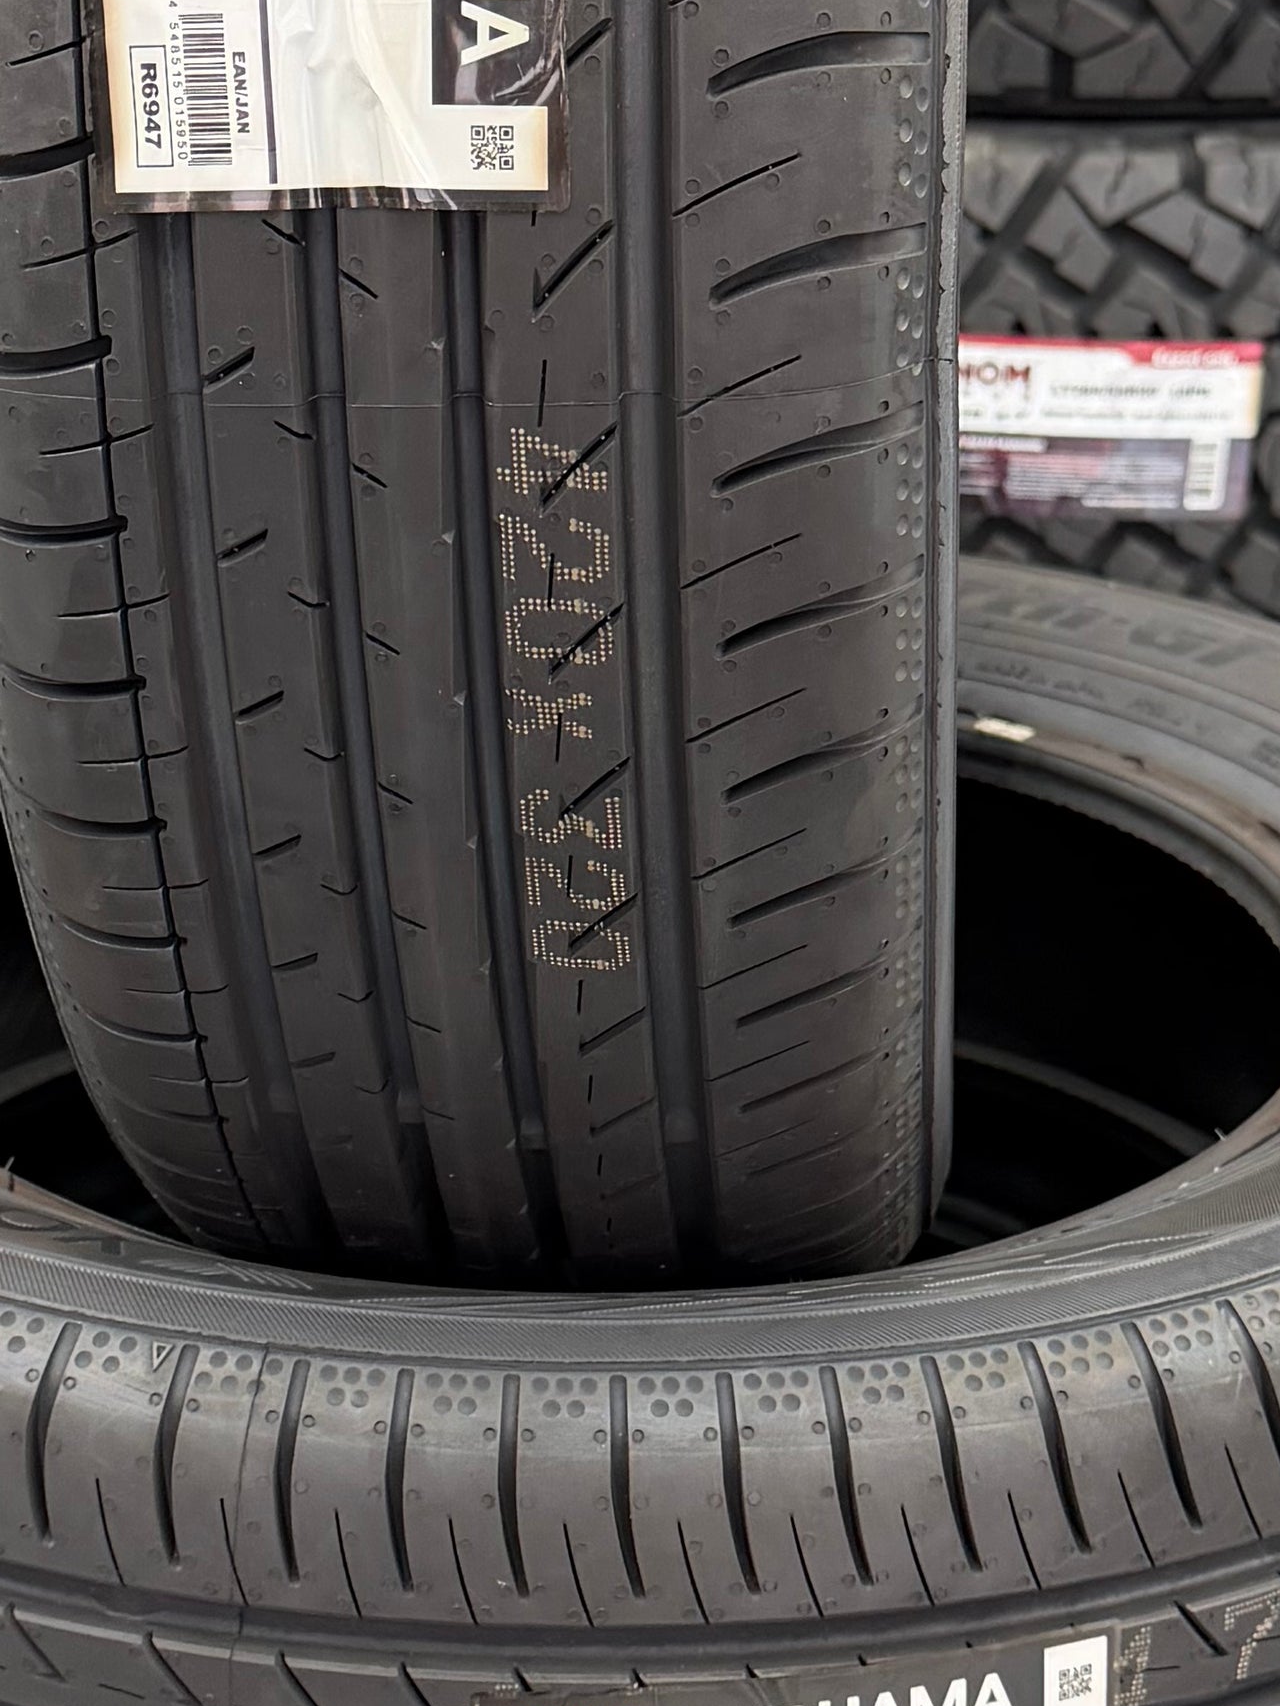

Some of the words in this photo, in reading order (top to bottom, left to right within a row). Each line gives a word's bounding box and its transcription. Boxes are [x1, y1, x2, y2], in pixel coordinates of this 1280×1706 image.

[169, 22, 182, 88] 548515
[140, 63, 162, 149] R6947
[174, 97, 188, 160] 015950
[232, 52, 250, 133] EAN/JAN
